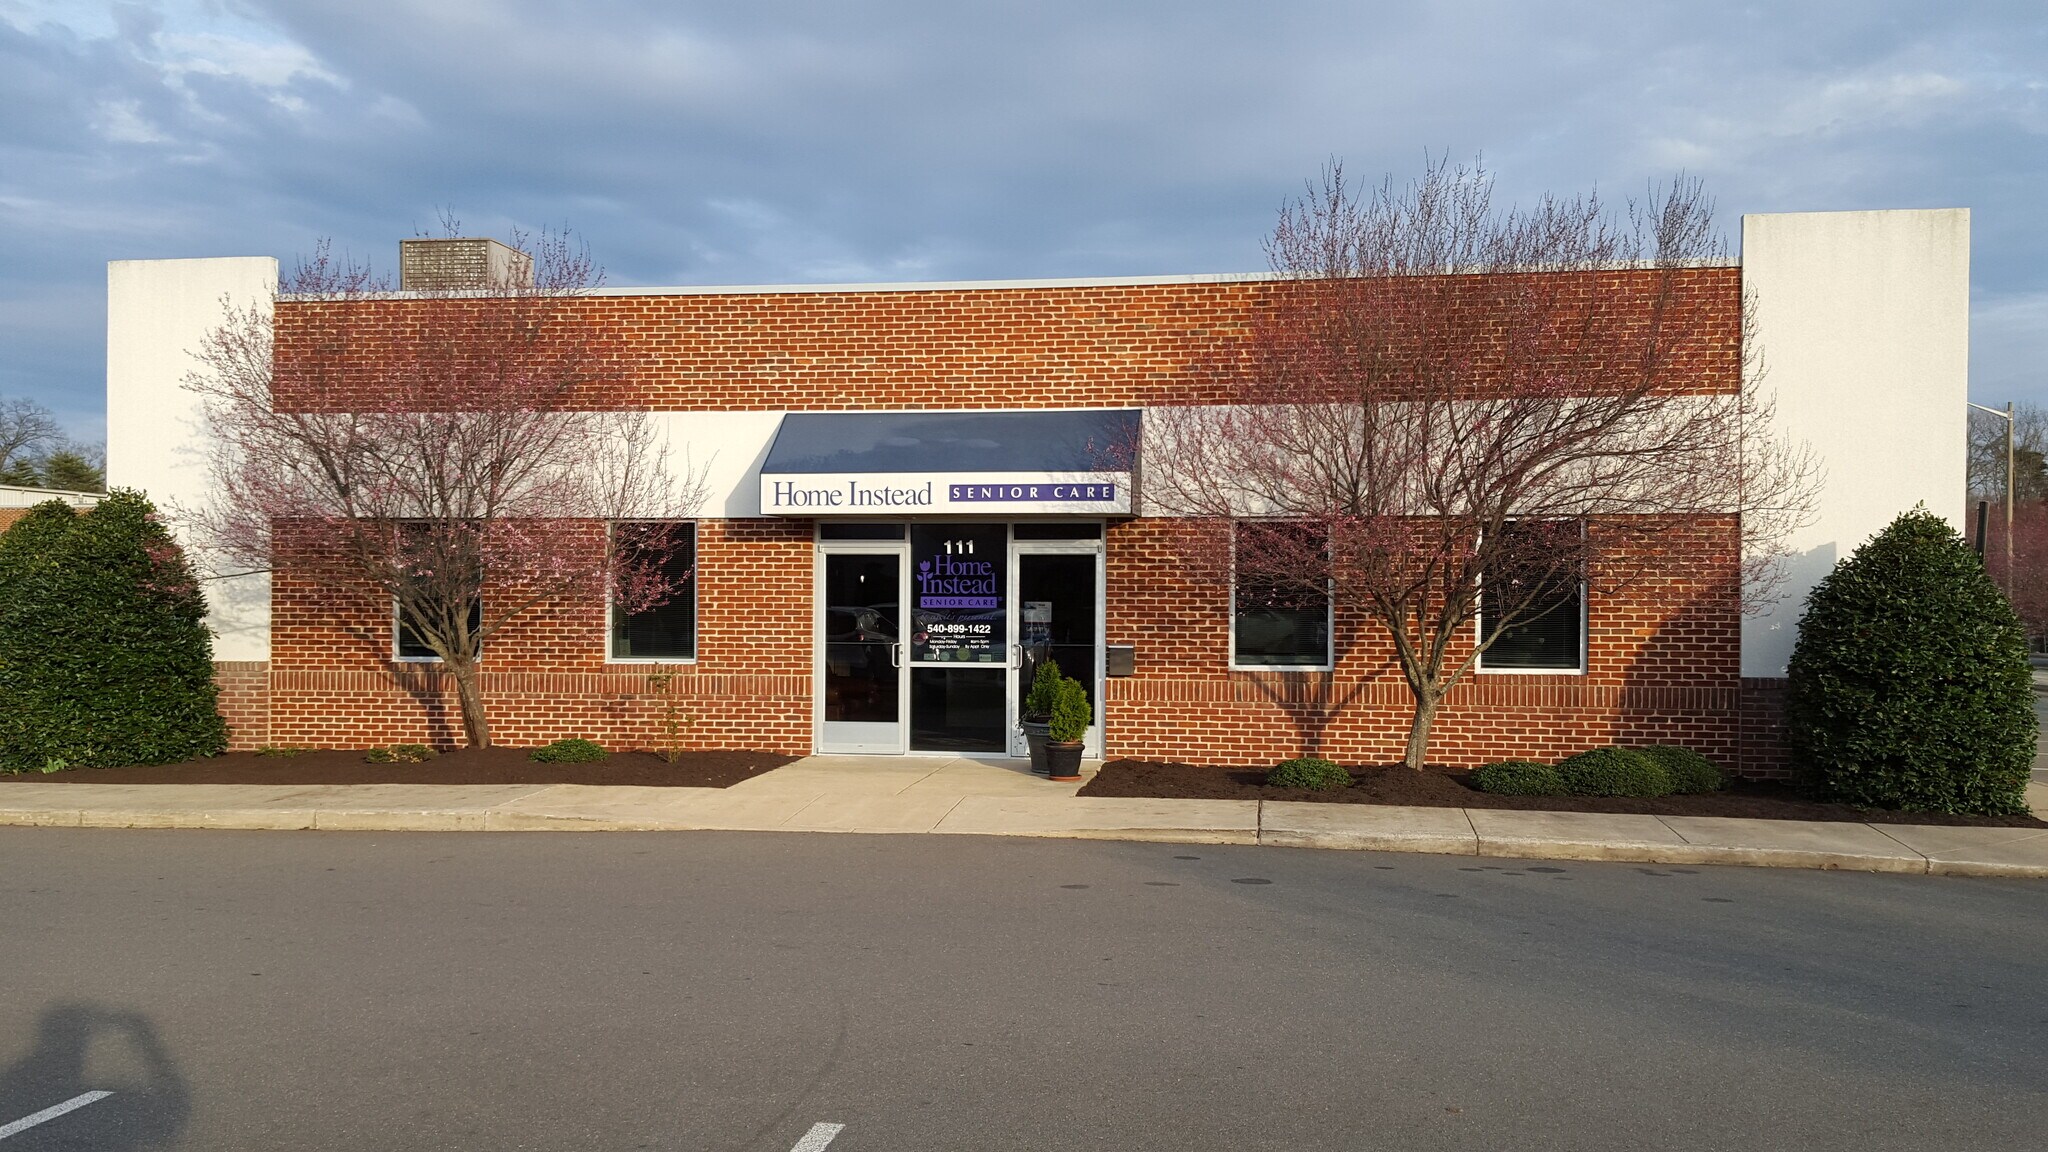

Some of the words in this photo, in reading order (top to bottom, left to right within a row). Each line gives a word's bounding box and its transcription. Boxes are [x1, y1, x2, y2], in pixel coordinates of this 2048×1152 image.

[773, 481, 843, 506] Home
[848, 481, 932, 506] Instead
[953, 487, 1038, 499] SENIOR
[1053, 486, 1110, 498] CARE
[944, 540, 974, 554] 111
[934, 555, 992, 575] Home
[920, 572, 997, 594] Instead
[927, 624, 991, 633] 540-899-1422
